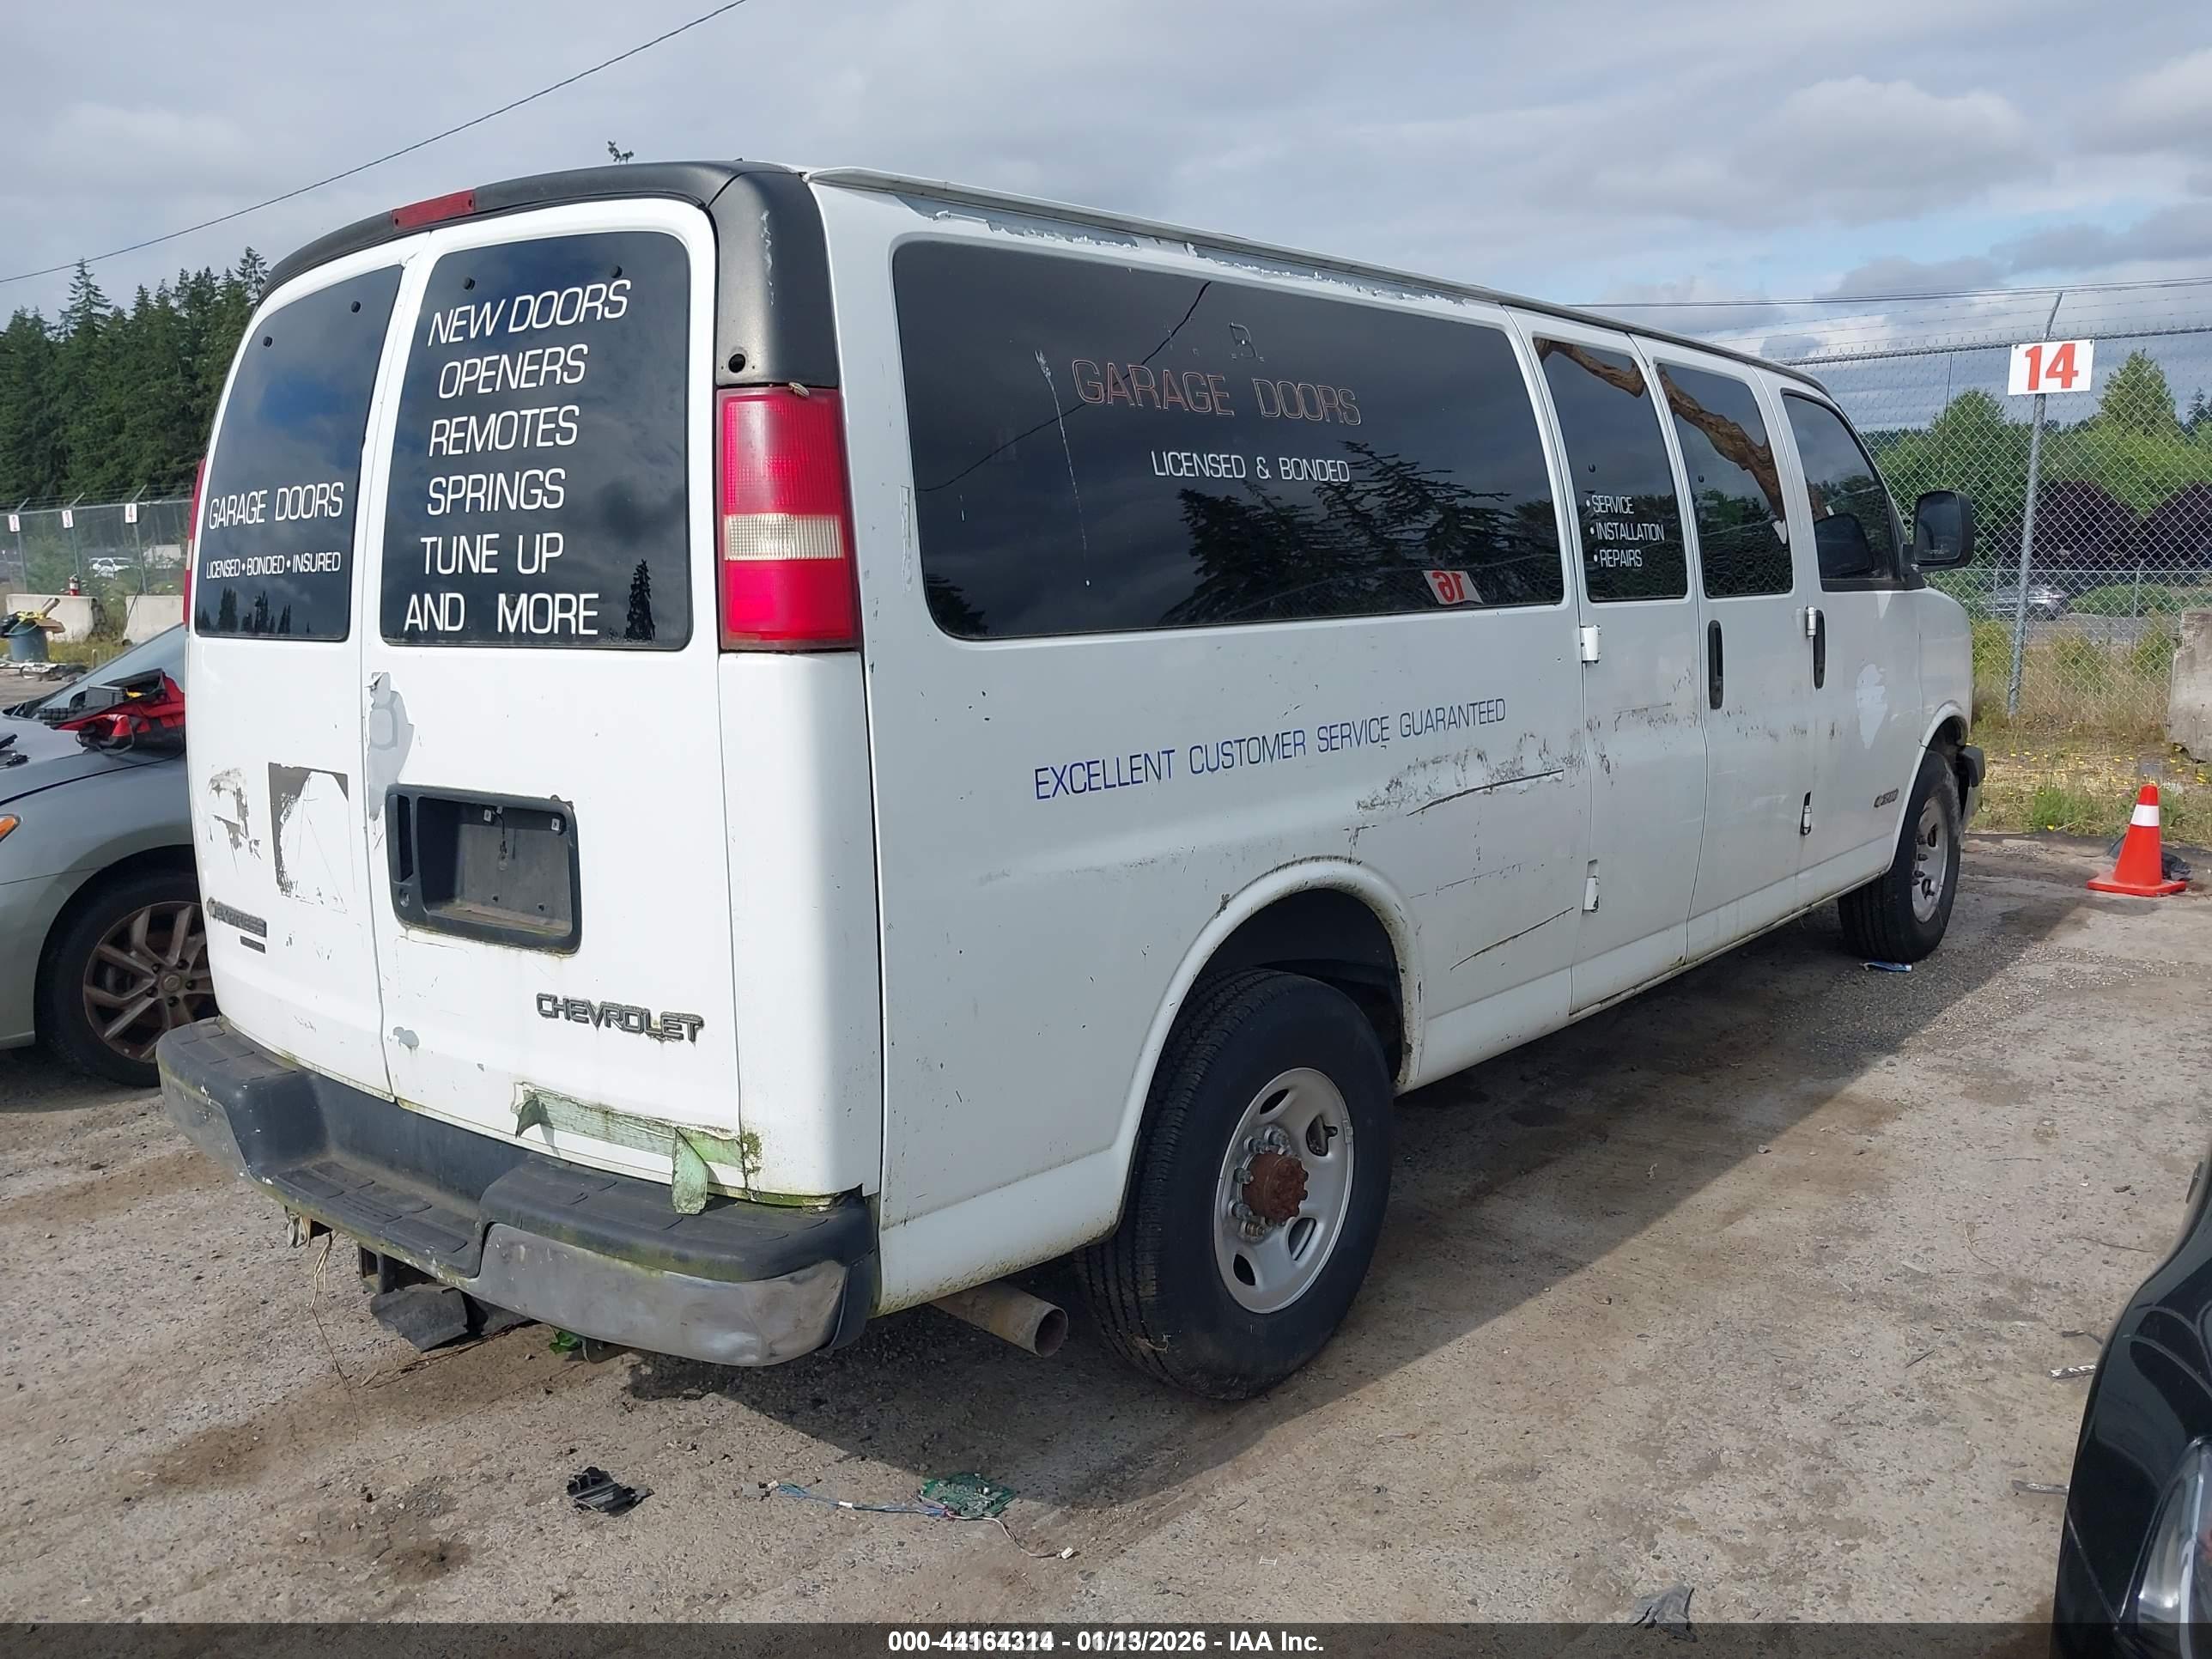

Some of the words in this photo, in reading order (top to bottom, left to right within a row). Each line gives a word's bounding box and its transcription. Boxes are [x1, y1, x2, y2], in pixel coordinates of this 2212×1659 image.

[428, 298, 507, 347] NEW
[507, 279, 632, 333] DOORS
[438, 343, 589, 399] OPENERS
[2025, 343, 2080, 391] 14
[1072, 359, 1236, 416] GARAGE
[1251, 378, 1361, 426] DOORS
[428, 404, 580, 457] REMOTES
[1151, 450, 1246, 479] LICENSED
[1256, 456, 1272, 479] &
[1279, 457, 1351, 483] BONDED
[209, 489, 268, 530] GARAGE
[275, 481, 344, 521] DOORS
[427, 467, 566, 516] SPRINGS
[1591, 495, 1635, 514] SERVICE
[420, 533, 500, 574] TUNE
[517, 532, 564, 574] UP
[1595, 521, 1665, 541] INSTALLATION
[206, 558, 241, 580] LICENSED
[246, 555, 285, 576] BONDED
[292, 551, 341, 574] INSURED
[1599, 549, 1643, 568] REPAIRS
[404, 592, 465, 631] AND
[497, 592, 599, 635] MORE
[1035, 749, 1176, 801] EXCELLENT
[1188, 729, 1307, 775] CUSTOMER
[1317, 714, 1389, 753] SERVICE
[1400, 697, 1506, 738] GUARANTEED
[536, 993, 704, 1043] CHEVROLET
